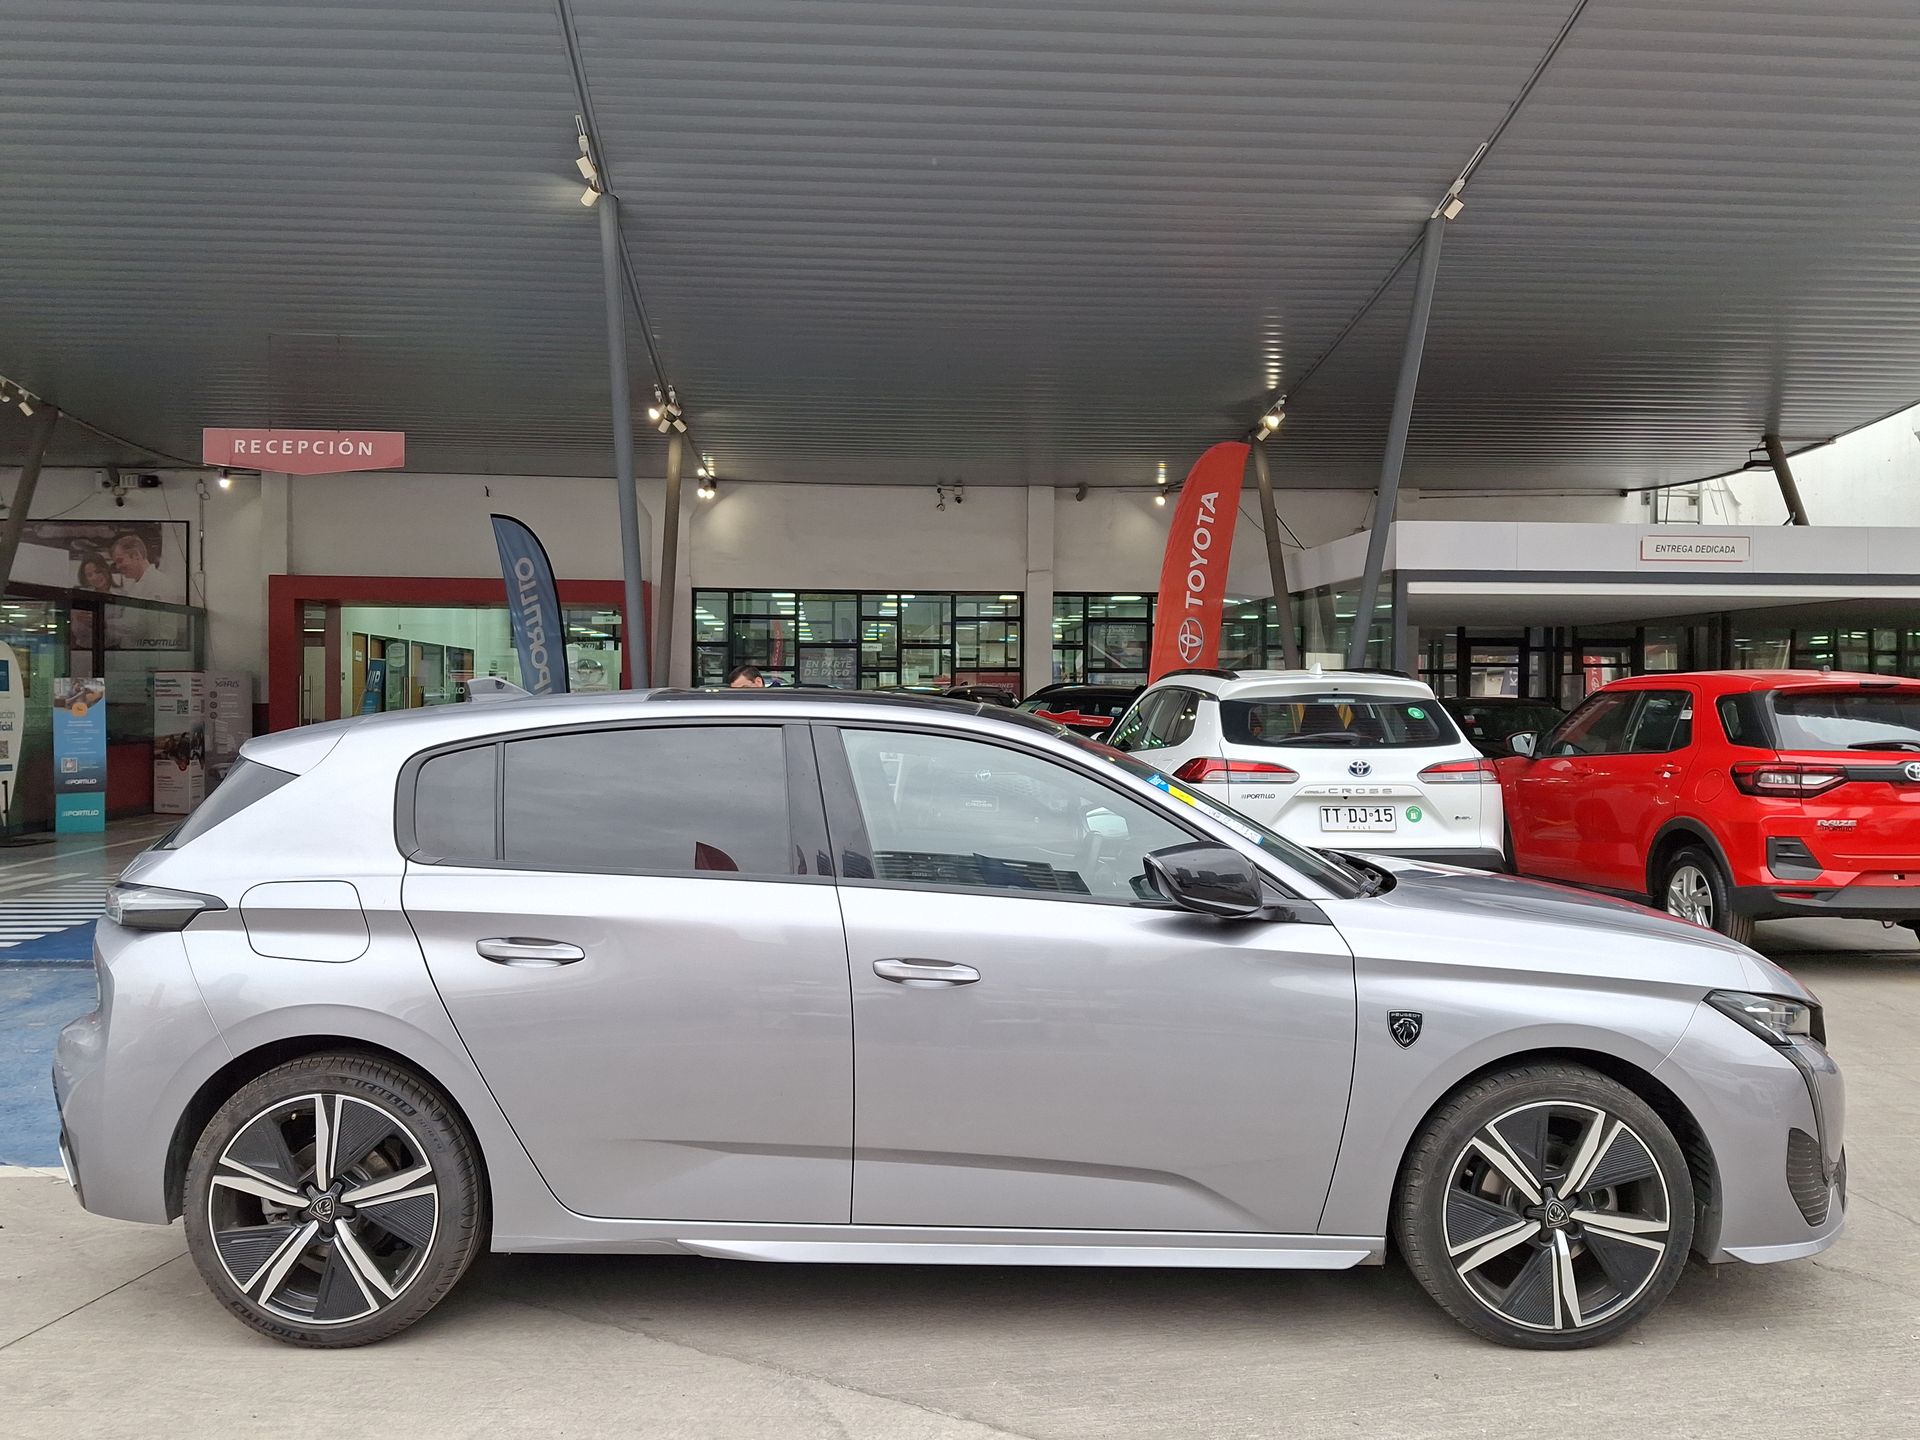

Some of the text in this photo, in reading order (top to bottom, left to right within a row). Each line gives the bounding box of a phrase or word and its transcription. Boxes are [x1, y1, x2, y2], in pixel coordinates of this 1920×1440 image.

[234, 438, 373, 456] RECEPCIÓN
[1185, 491, 1219, 609] TOYOTA
[1655, 544, 1736, 554] ENTREGA DEDICADA
[806, 660, 853, 669] EN PARTE
[804, 668, 850, 677] DE PAGO
[343, 1076, 415, 1117] MICHELIN
